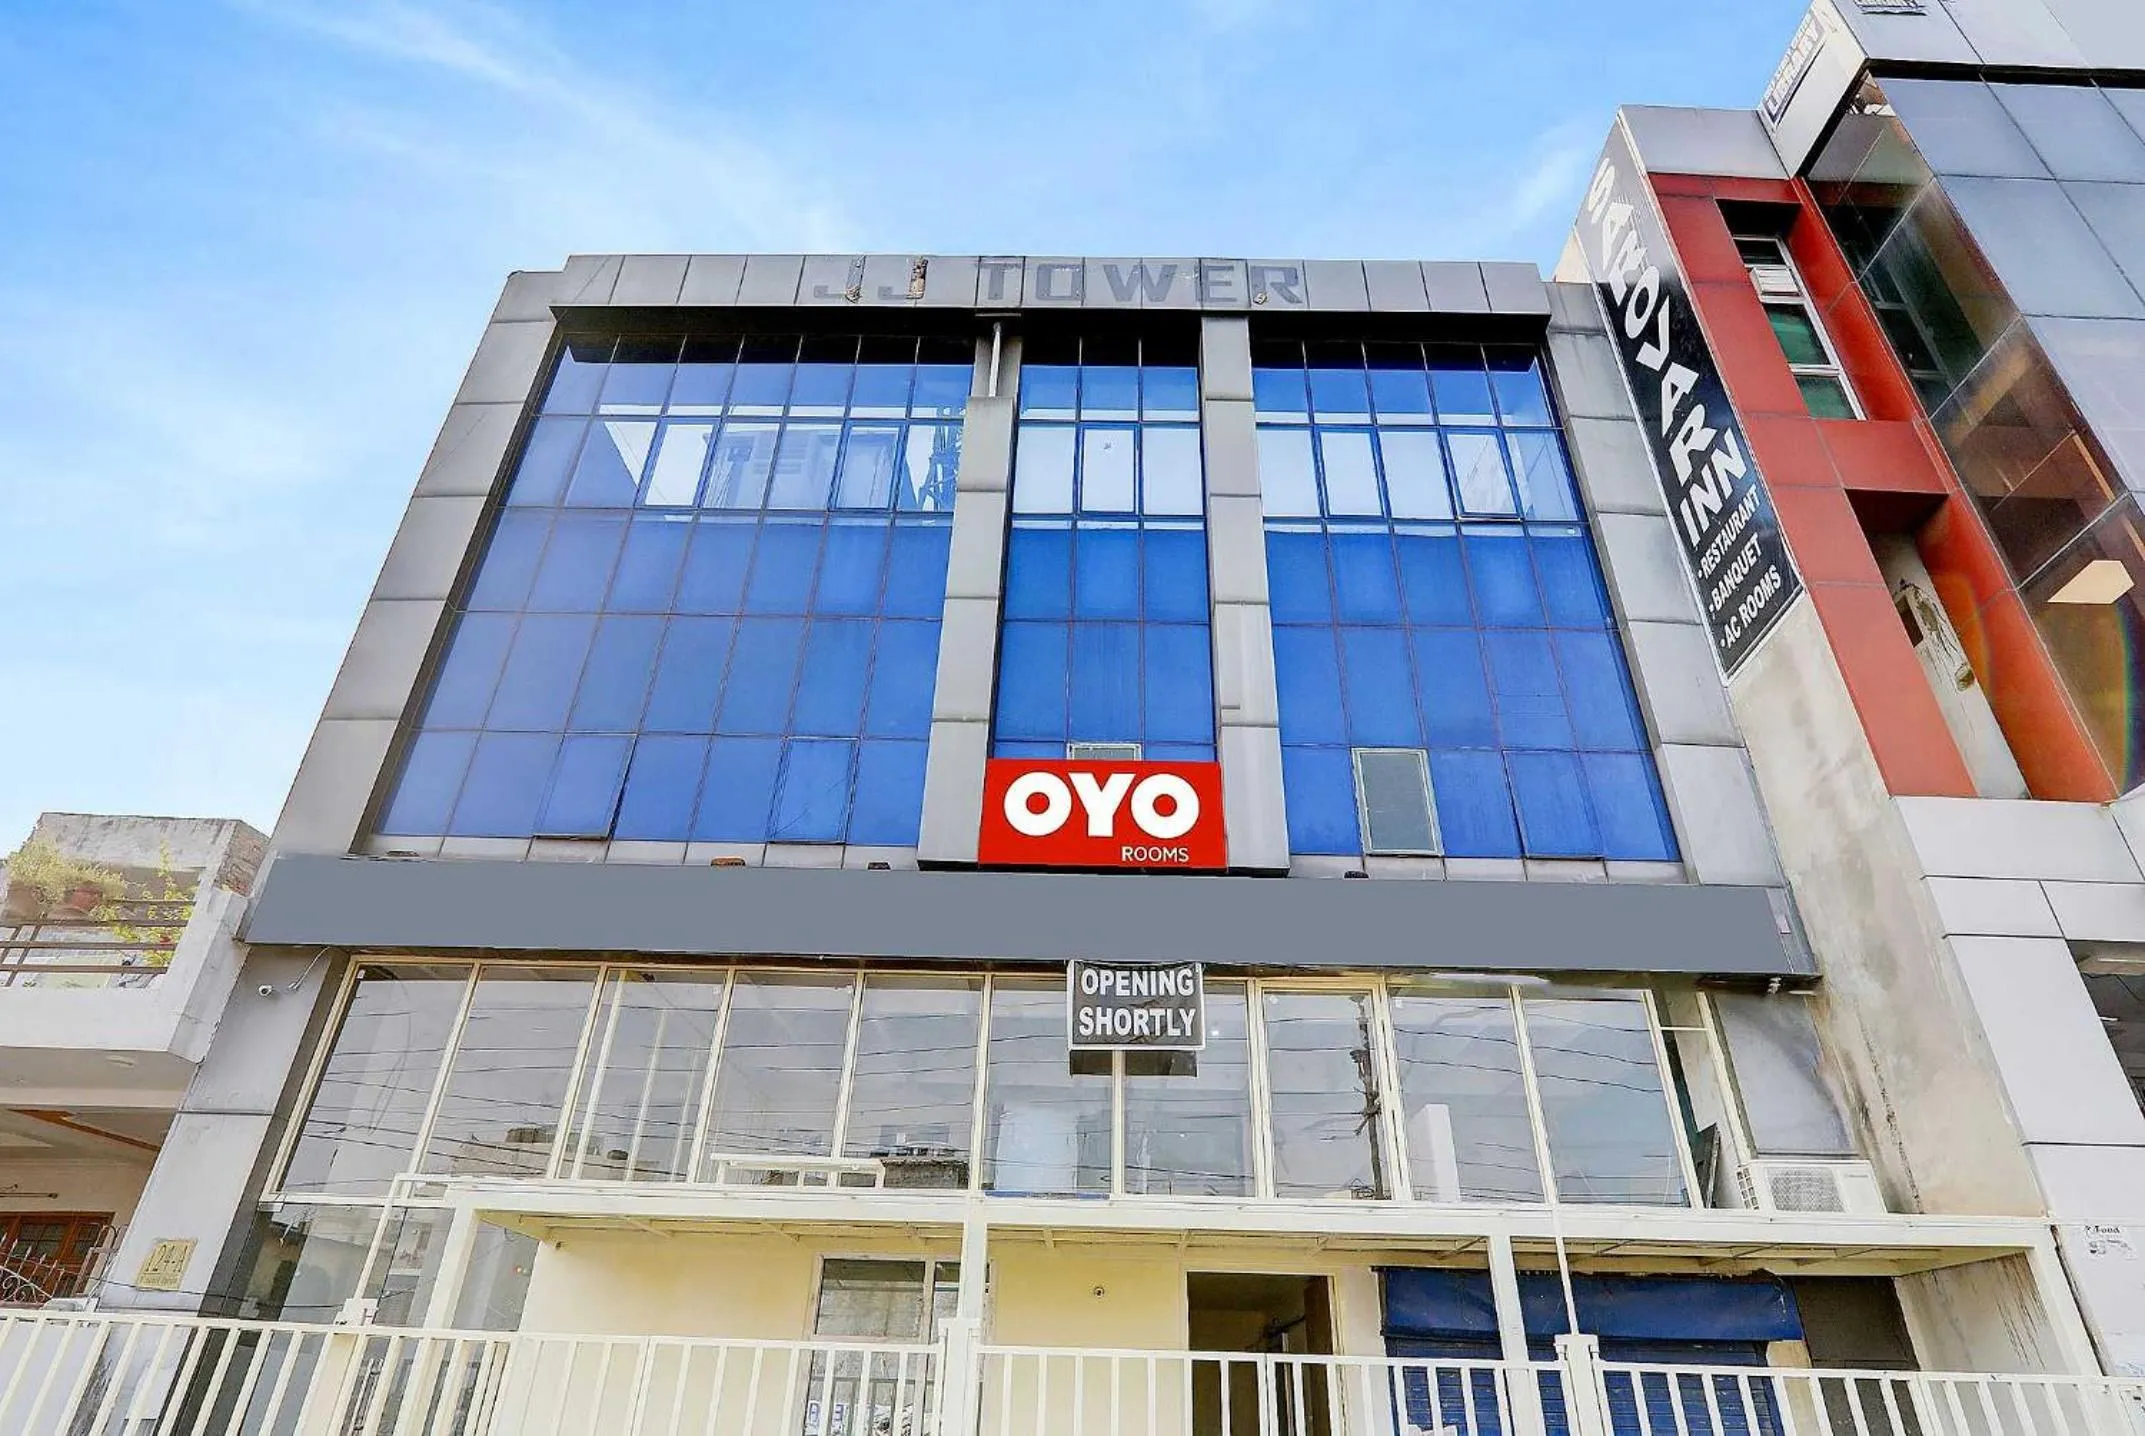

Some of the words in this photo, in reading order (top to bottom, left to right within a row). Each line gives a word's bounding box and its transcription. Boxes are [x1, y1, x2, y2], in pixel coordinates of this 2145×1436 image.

[975, 262, 1304, 303] TOWER
[1587, 157, 1718, 487] SAROVAR
[1680, 428, 1748, 547] INN
[1700, 484, 1761, 580] RESTAURANT
[1711, 532, 1762, 613] BANQUET
[1724, 615, 1742, 649] AC
[1739, 564, 1782, 629] ROOMS
[1003, 771, 1201, 840] OYO
[1121, 846, 1190, 863] ROOMS
[1080, 968, 1195, 997] OPENING
[1078, 1007, 1196, 1037] SHORTLY
